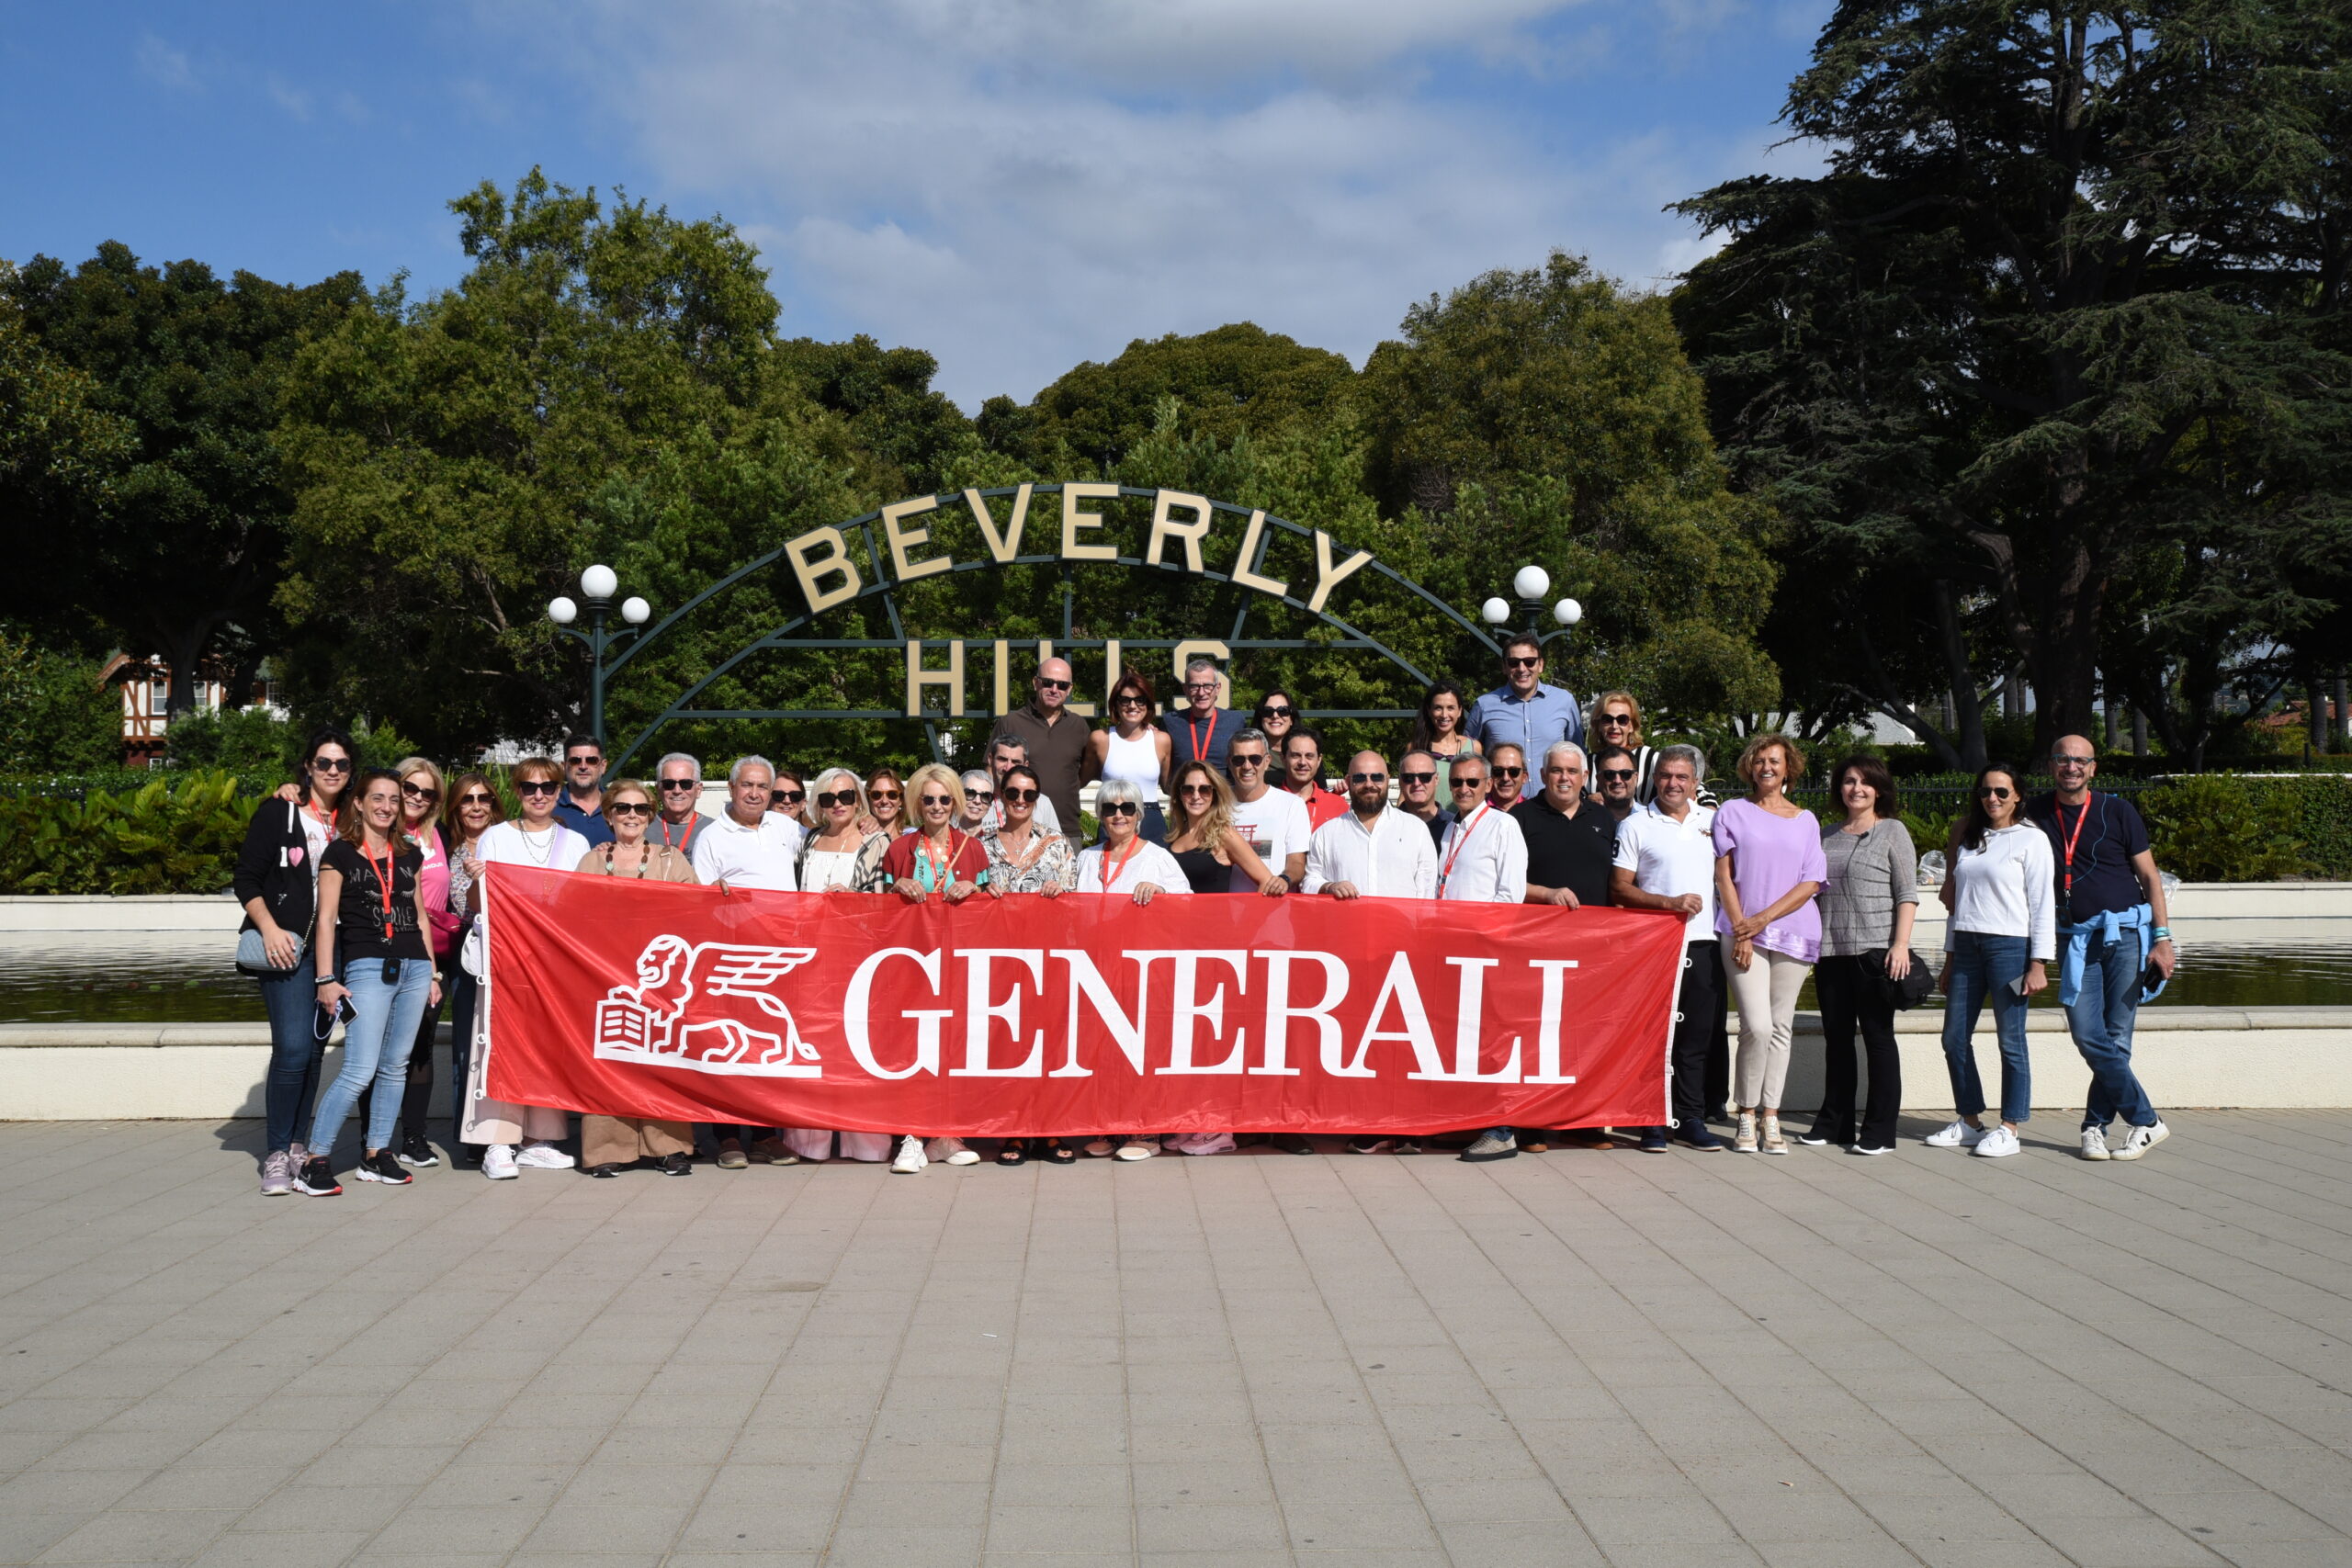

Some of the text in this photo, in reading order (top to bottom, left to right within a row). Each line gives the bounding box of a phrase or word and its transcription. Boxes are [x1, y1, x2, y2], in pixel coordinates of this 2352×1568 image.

[784, 482, 1374, 615] BEVERLY
[349, 867, 390, 884] MAE
[843, 947, 1578, 1084] GENERALI
